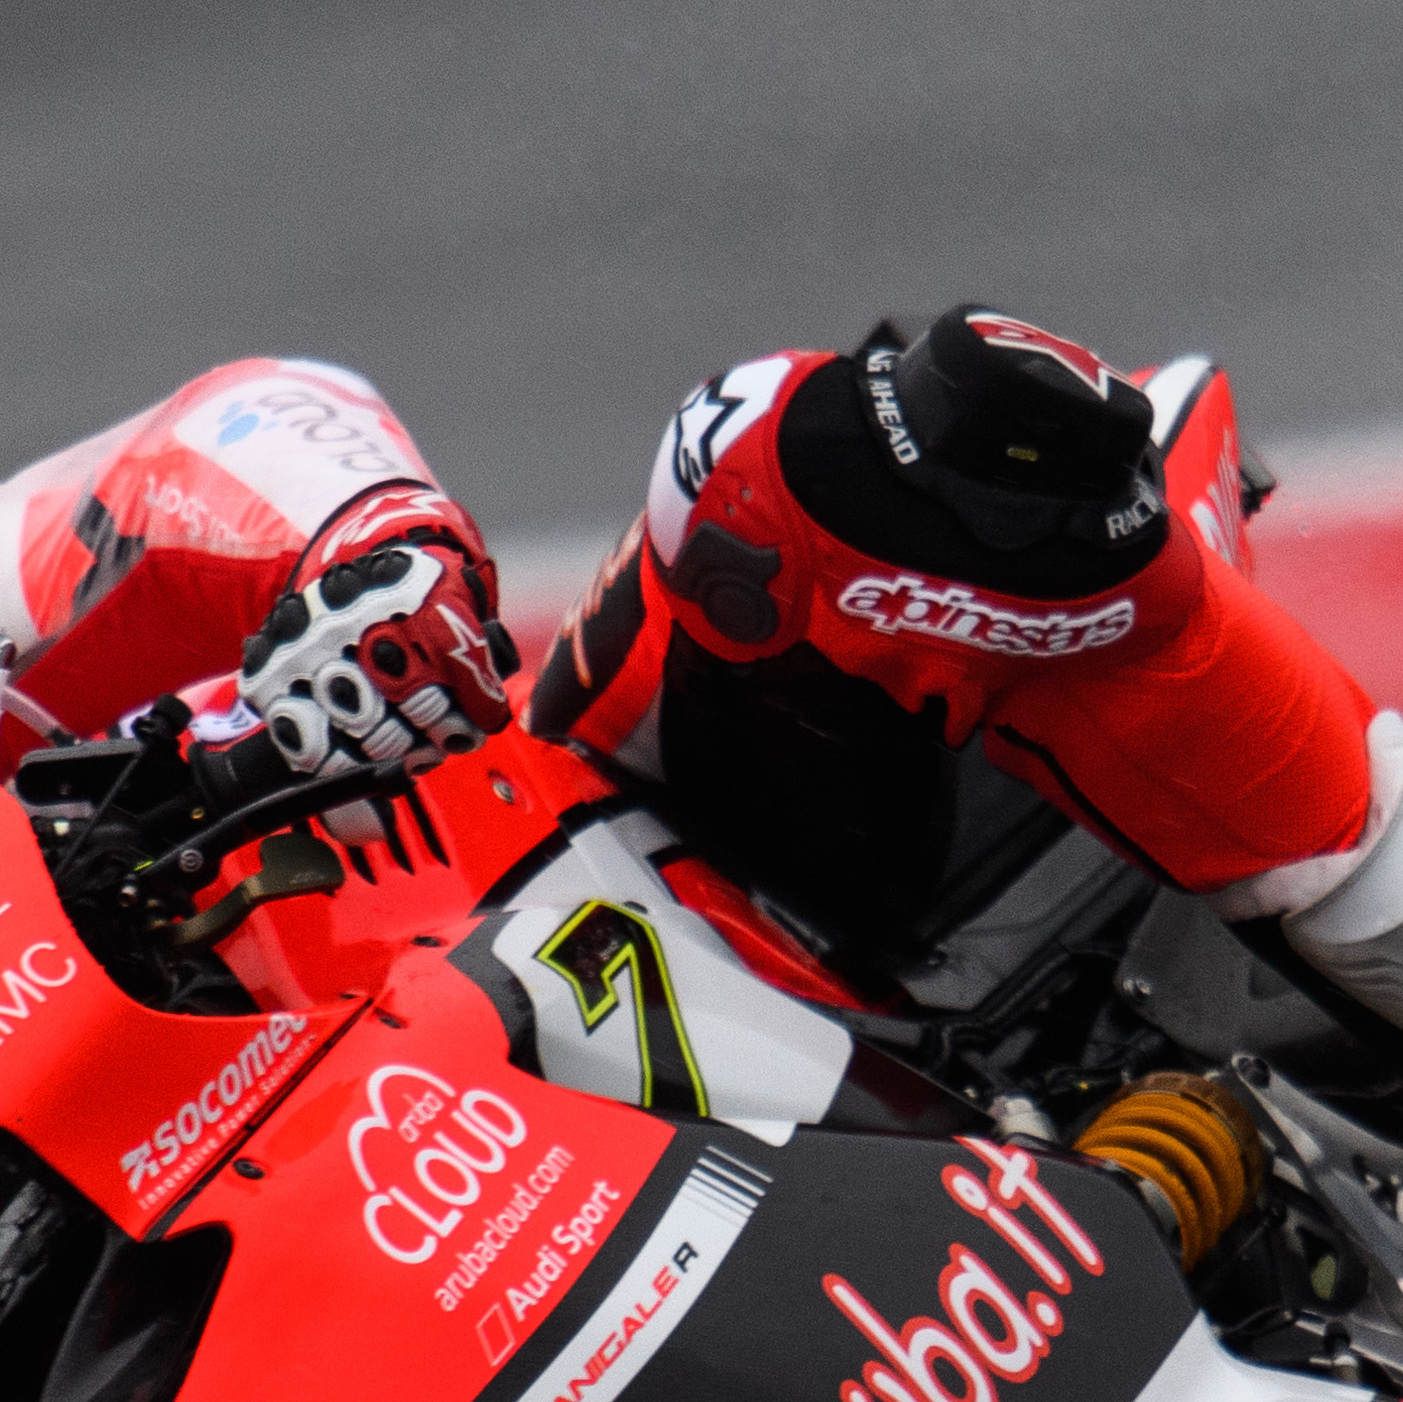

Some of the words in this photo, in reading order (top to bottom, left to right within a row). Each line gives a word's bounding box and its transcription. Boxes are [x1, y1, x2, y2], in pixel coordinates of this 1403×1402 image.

[868, 376, 921, 466] AHEAD
[533, 899, 711, 1118] 7
[363, 1087, 528, 1265] CLOUD
[398, 1090, 446, 1143] aruba
[433, 1144, 576, 1312] arubacloud.com
[504, 1246, 569, 1322] Audi
[553, 1178, 622, 1256] Sport
[673, 1240, 700, 1275] R
